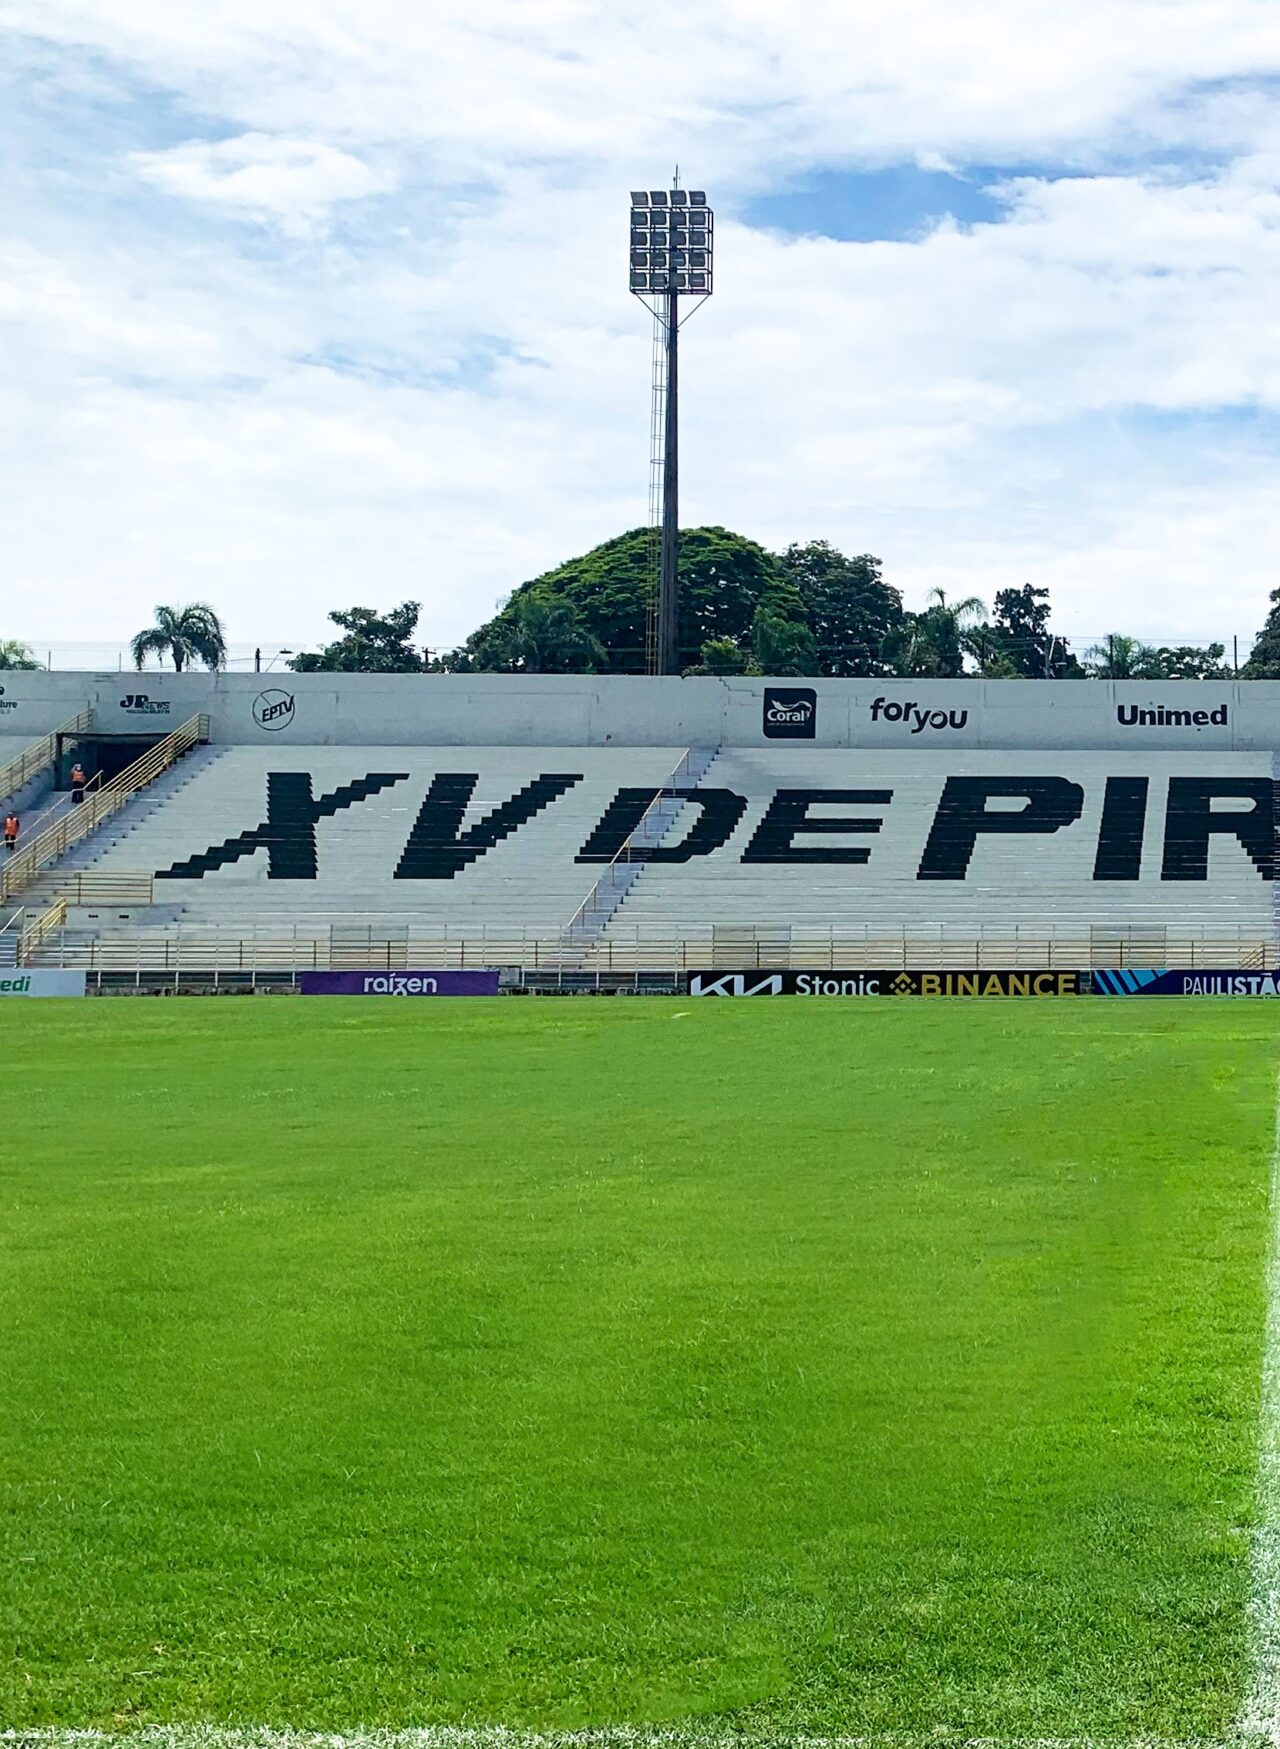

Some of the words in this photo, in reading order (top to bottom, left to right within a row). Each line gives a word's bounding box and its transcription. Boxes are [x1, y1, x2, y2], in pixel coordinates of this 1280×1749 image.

[262, 695, 294, 722] EPTV
[767, 709, 805, 721] Coral
[1117, 704, 1228, 725] Unimed
[155, 772, 584, 880] XV
[574, 787, 894, 865] DE
[364, 973, 438, 996] raízen
[795, 975, 880, 996] Stonic
[921, 974, 1076, 996] BINANCE
